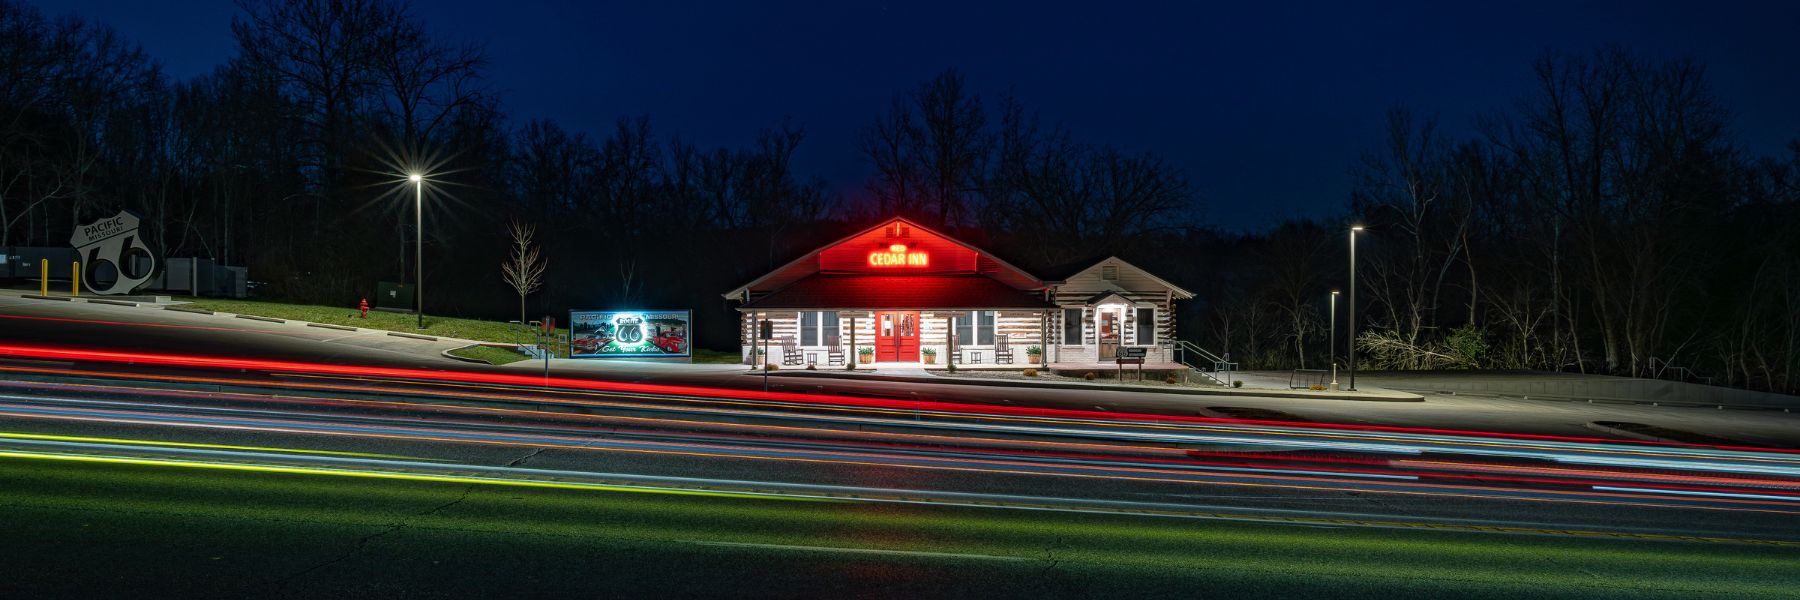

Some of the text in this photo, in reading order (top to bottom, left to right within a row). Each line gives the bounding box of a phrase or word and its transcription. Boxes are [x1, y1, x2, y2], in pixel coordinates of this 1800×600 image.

[84, 217, 124, 236] PACIFIC
[88, 226, 124, 241] MISSOURI
[85, 235, 152, 291] 66
[869, 253, 927, 265] CEDAR INN
[618, 326, 639, 341] 66
[618, 345, 637, 353] Your
